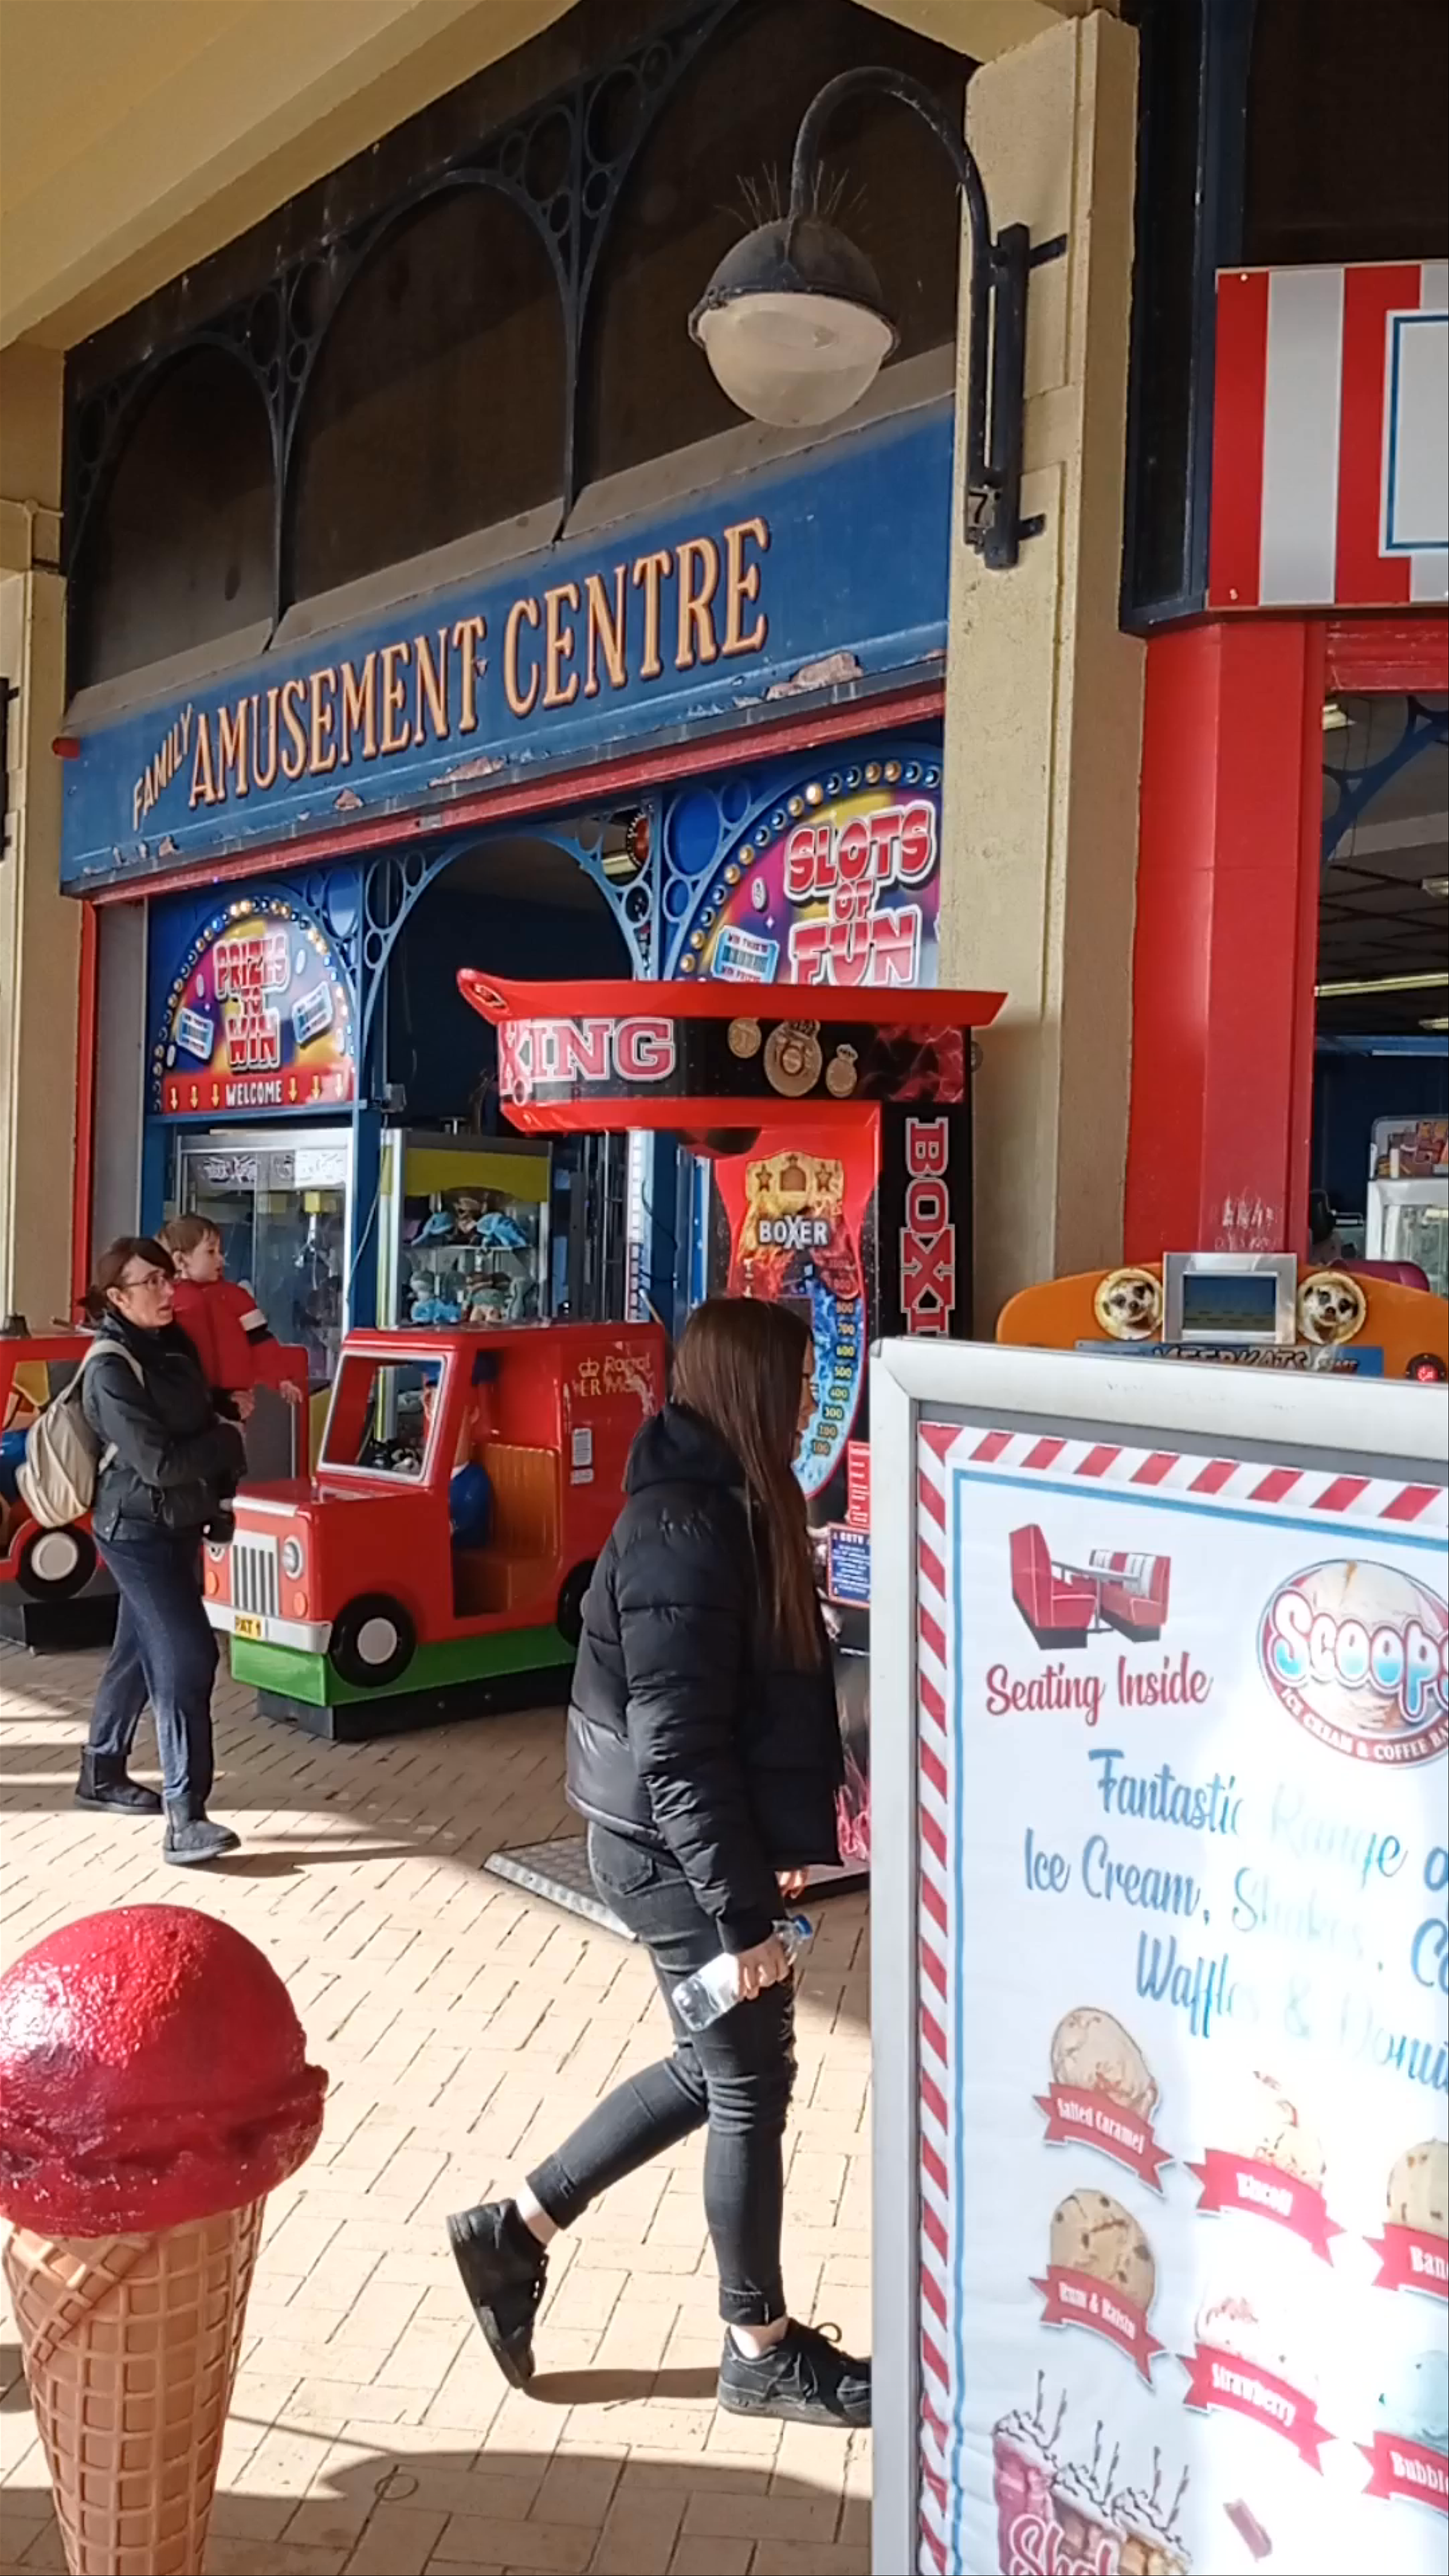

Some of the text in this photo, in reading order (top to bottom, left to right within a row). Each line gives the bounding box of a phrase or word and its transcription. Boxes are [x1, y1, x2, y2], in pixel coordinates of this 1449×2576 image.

[969, 492, 988, 524] 7
[132, 516, 770, 832] FAMILY AMUSEMENT CENTRE
[786, 801, 936, 900] SLOTS
[832, 877, 877, 923] OF
[789, 907, 921, 986] FUN
[226, 1008, 280, 1071] WIN
[226, 1081, 282, 1106] WELCOME
[759, 1215, 828, 1250] BOXER
[580, 1378, 601, 1396] ER
[235, 1616, 261, 1637] PAT 1
[986, 1651, 1214, 1727] Seating Inside
[1280, 1688, 1304, 1718] ICE
[1303, 1711, 1355, 1755] CREAM
[1374, 1738, 1428, 1761] COFFEE
[1088, 1749, 1245, 1836] Fantastic
[1024, 1827, 1071, 1894] Ice
[1082, 1835, 1210, 1925] Cream,
[1058, 2098, 1145, 2155] Salted Caramel
[1410, 2245, 1449, 2280] Ban
[1058, 2281, 1135, 2340] Rum & Raisin
[1212, 2363, 1297, 2427] Strawberry
